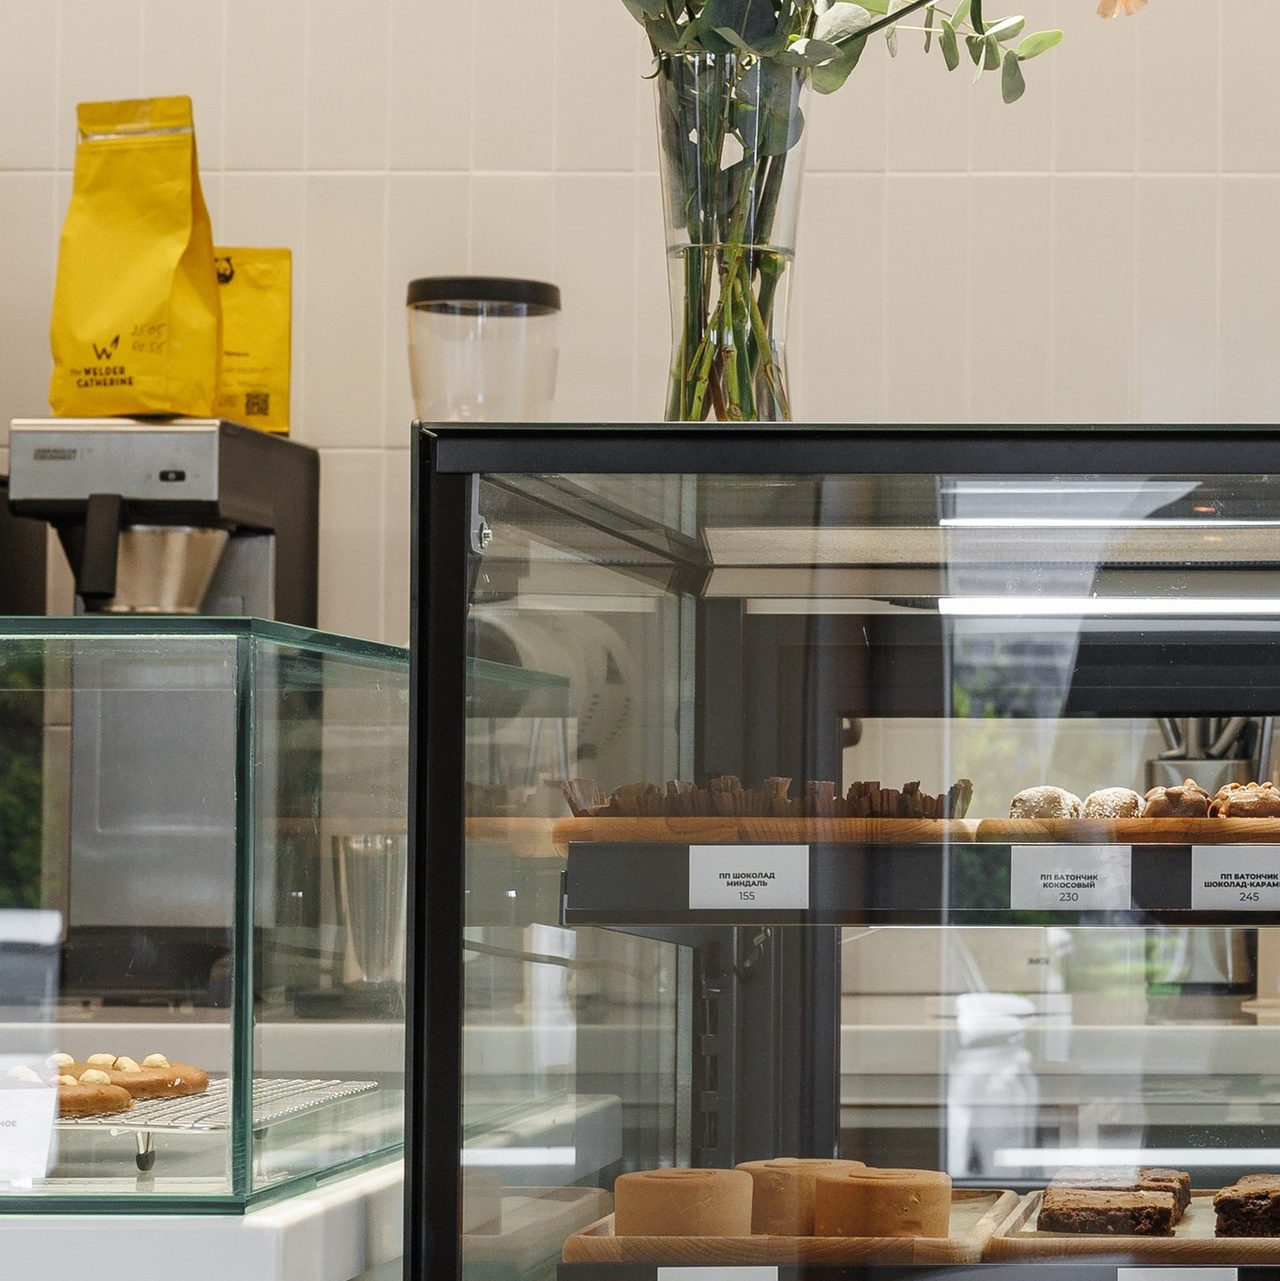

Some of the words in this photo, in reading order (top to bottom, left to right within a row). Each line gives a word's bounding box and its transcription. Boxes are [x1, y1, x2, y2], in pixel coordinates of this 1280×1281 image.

[718, 872, 731, 880] ПП
[732, 872, 776, 880] ШОКОЛАД
[1040, 873, 1053, 881] ПП
[1053, 873, 1099, 881] БАТОНЧИК
[726, 880, 768, 888] МИНДАЛЬ
[1042, 879, 1097, 889] КОКОСОВЫЙ
[738, 891, 756, 901] 155
[1059, 892, 1079, 902] 230
[1239, 891, 1260, 902] 245
